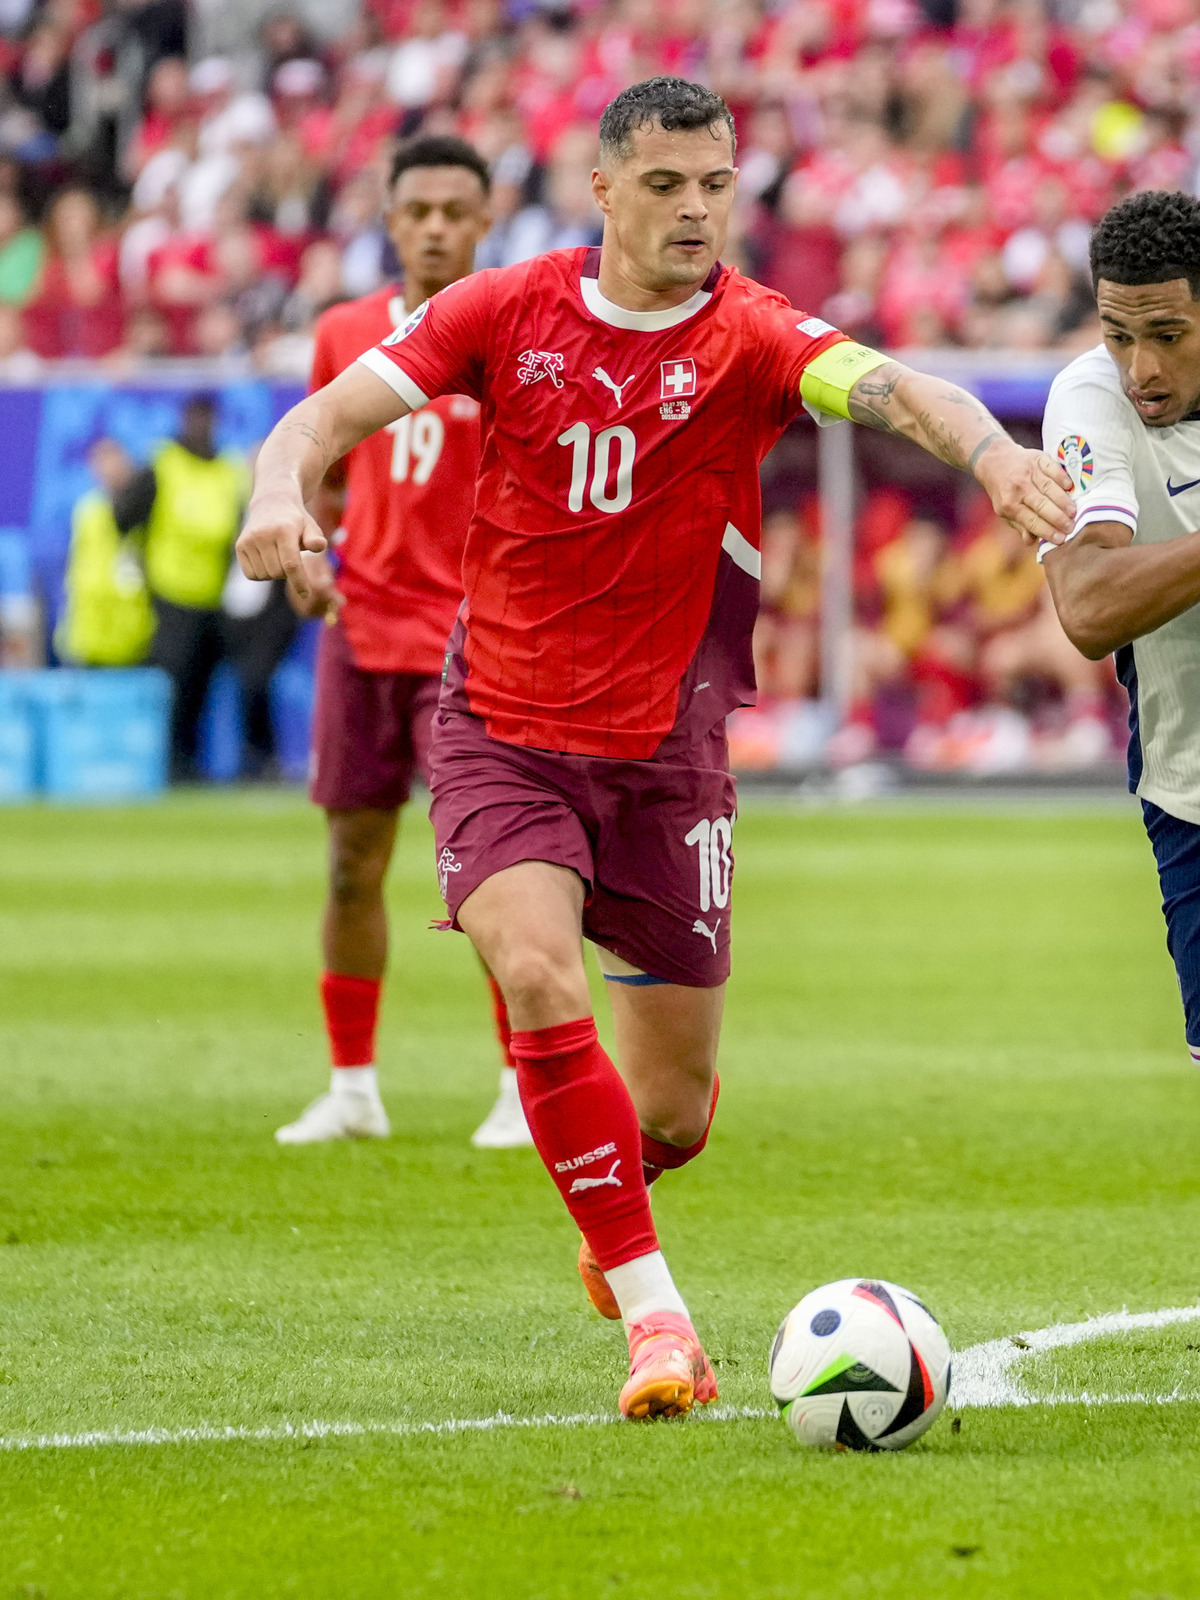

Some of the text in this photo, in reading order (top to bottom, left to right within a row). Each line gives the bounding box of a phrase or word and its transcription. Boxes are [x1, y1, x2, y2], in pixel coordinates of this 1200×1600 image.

[383, 410, 445, 485] 19
[659, 406, 673, 415] ENG
[557, 421, 637, 513] 10
[684, 815, 732, 912] 10
[554, 1141, 618, 1173] SUISSE
